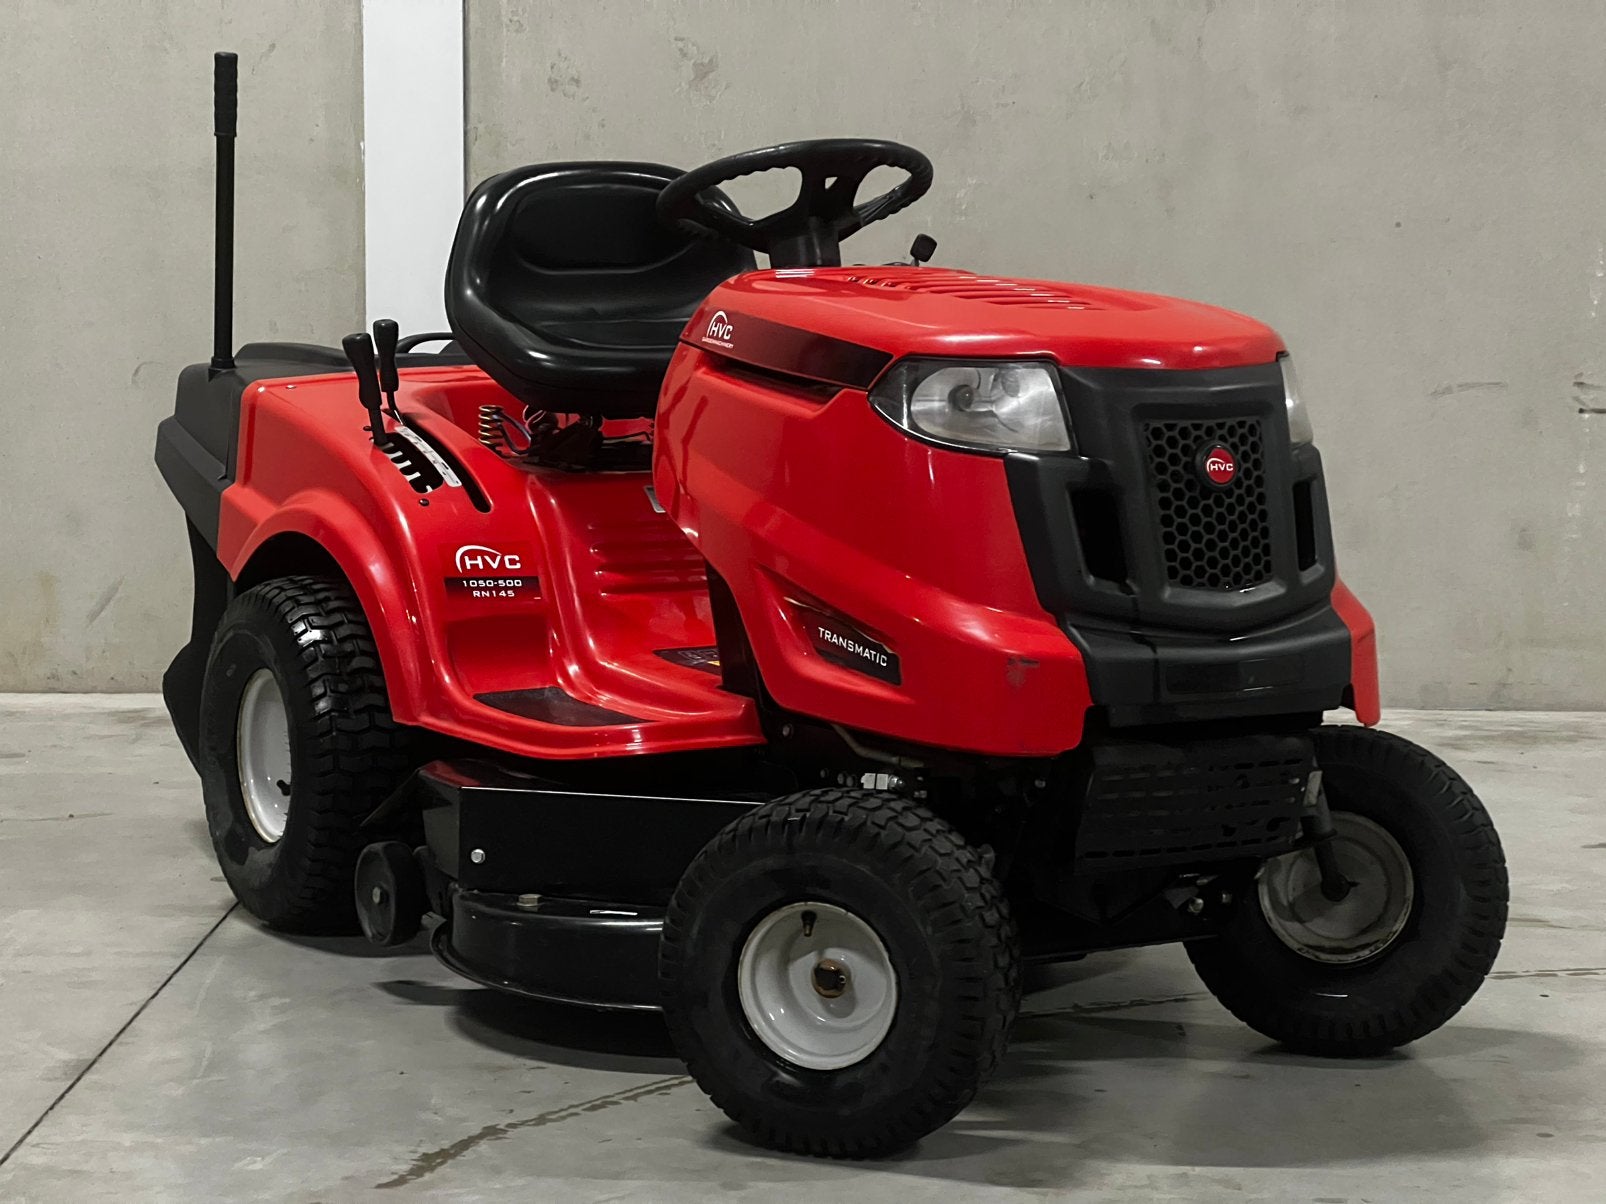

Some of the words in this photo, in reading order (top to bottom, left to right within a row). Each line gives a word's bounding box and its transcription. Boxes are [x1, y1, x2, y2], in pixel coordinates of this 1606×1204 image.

[709, 321, 734, 340] HVC
[1210, 463, 1234, 472] HVC
[463, 554, 522, 570] HVC
[462, 579, 523, 588] 1050-500
[472, 590, 515, 598] RN145
[818, 626, 888, 667] TRANSMATIC
